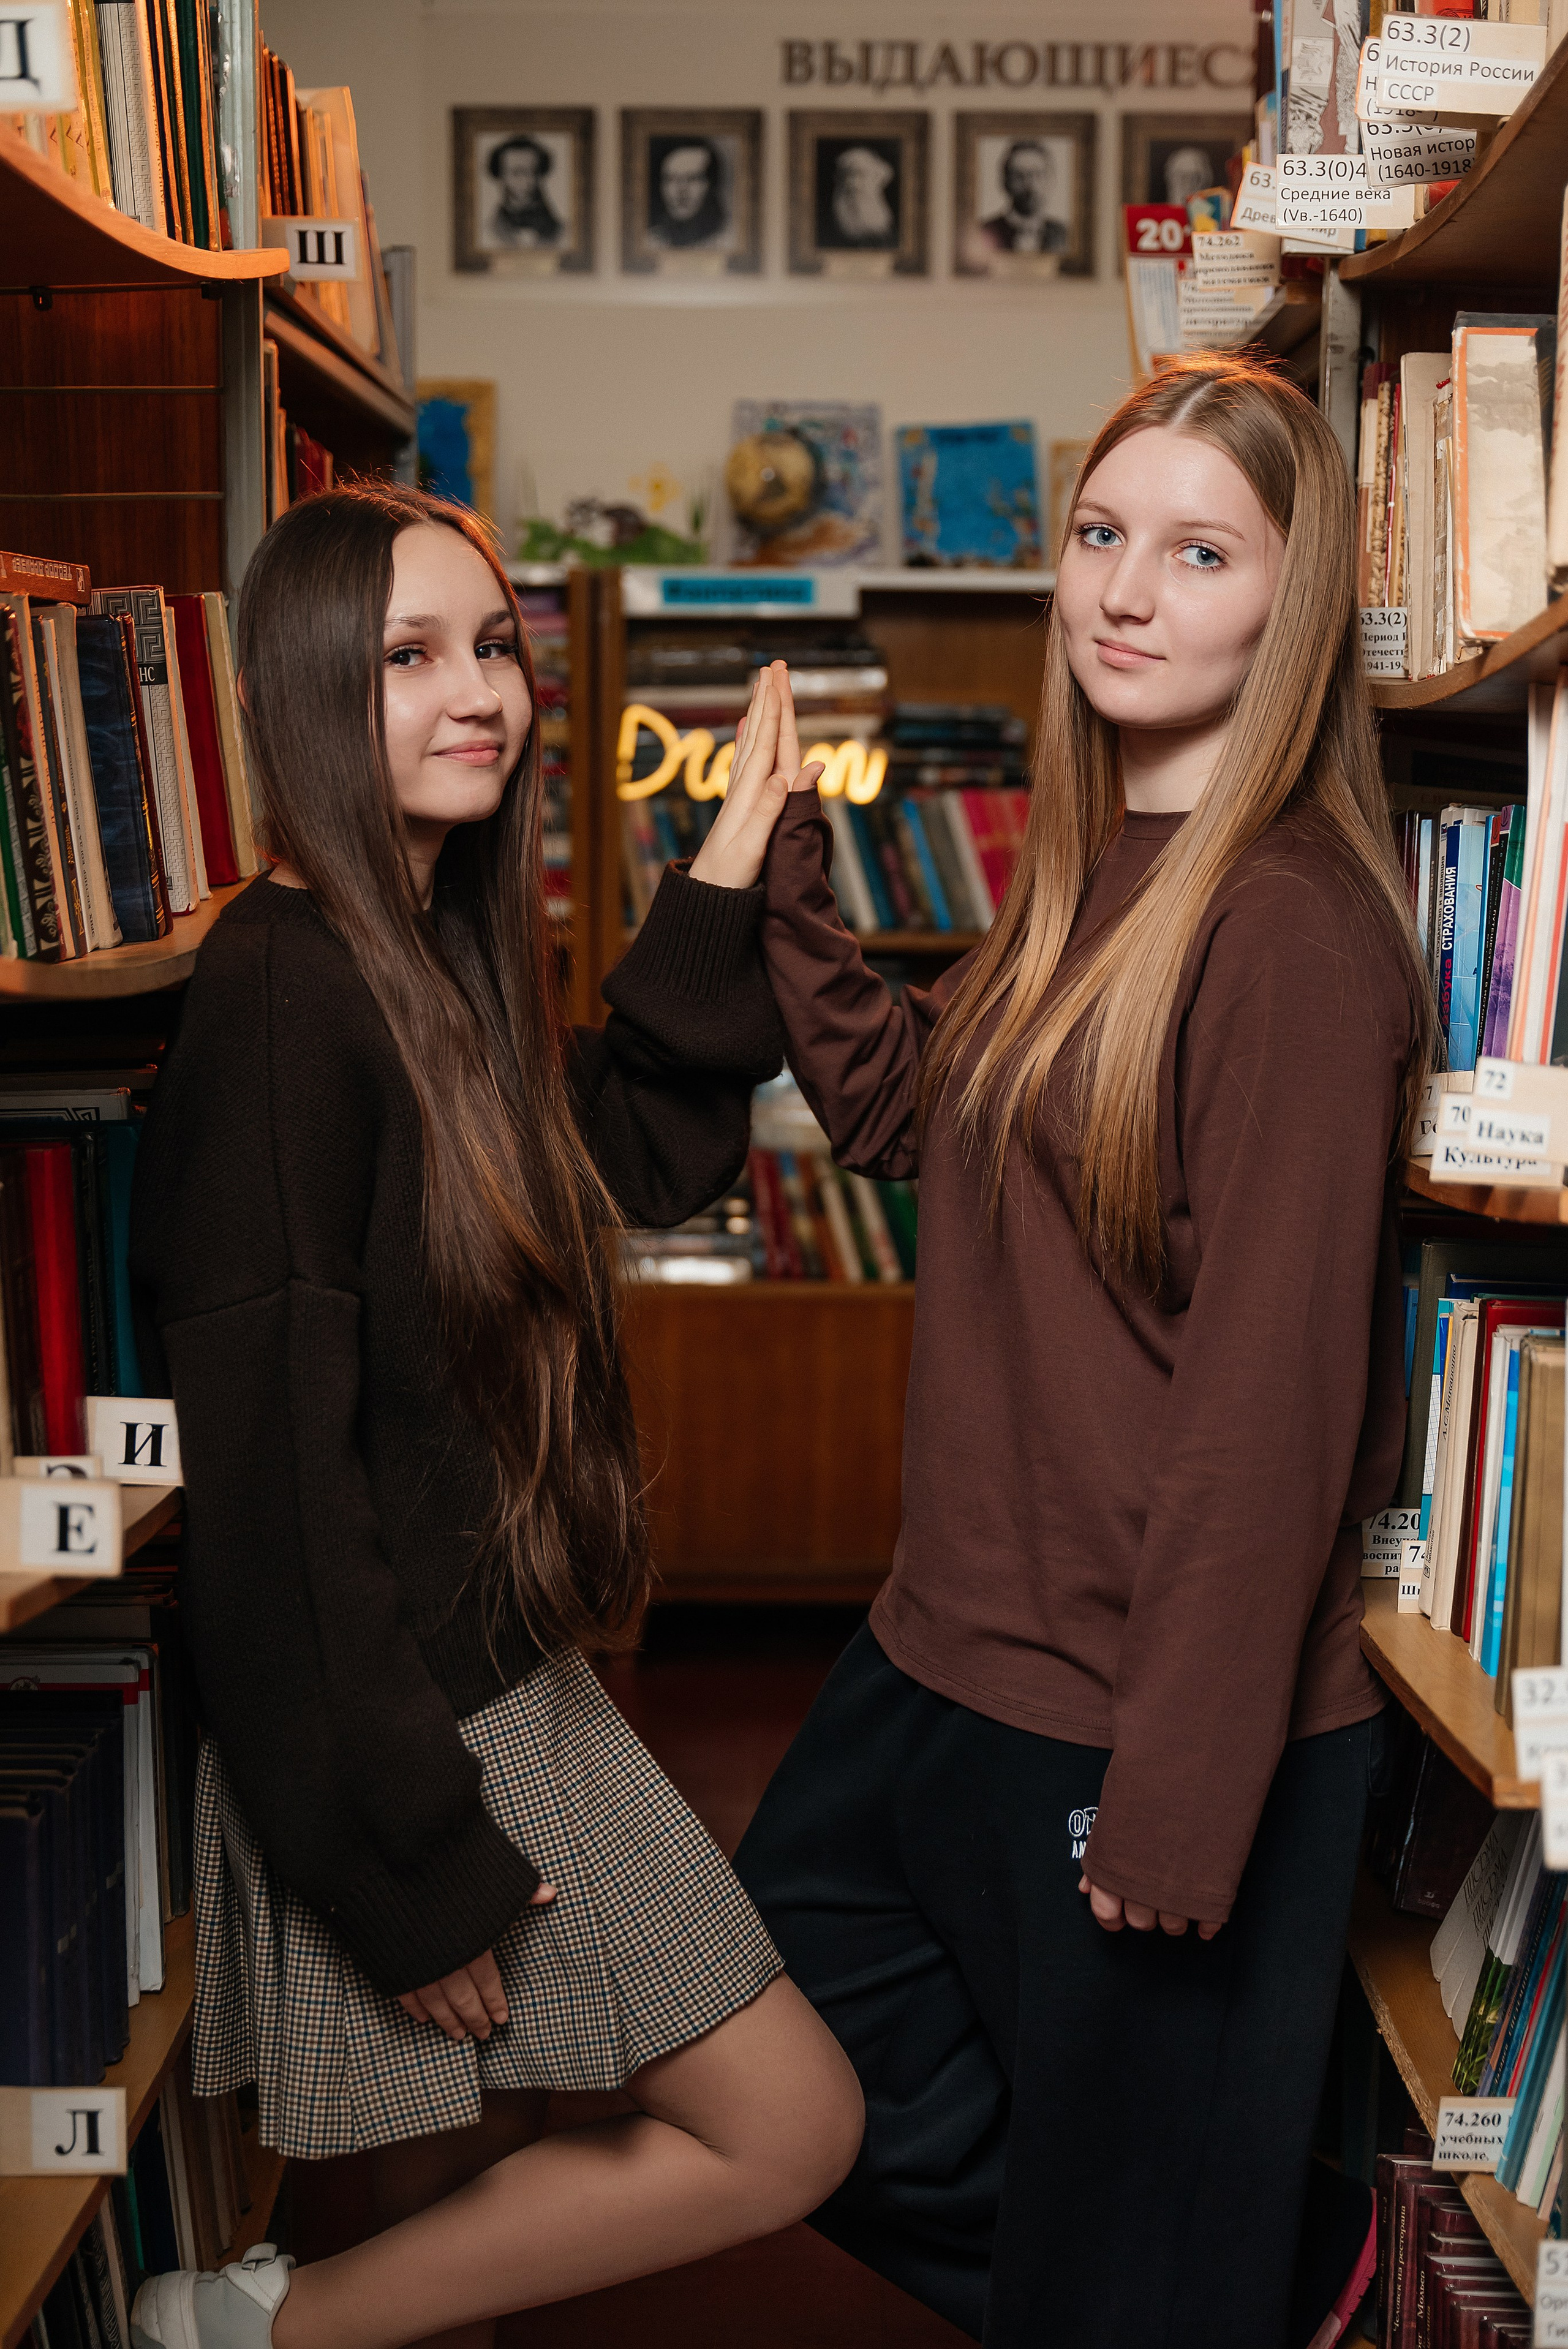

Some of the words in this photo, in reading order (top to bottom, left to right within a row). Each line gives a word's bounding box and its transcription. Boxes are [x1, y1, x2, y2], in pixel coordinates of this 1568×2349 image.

[1387, 20, 1471, 52] 63.3(2)
[782, 39, 1257, 94] ВЫДАЮЩИЕС
[1386, 55, 1463, 77] История
[1469, 62, 1534, 81] России
[1388, 83, 1434, 101] СССР
[1370, 145, 1421, 160] Новая
[1427, 138, 1475, 154] истор
[1283, 160, 1366, 181] 63.3(0)4
[1378, 157, 1475, 182] (1640-1918
[1281, 187, 1350, 203] Средние
[1355, 189, 1391, 200] века
[298, 230, 345, 265] Ш
[1136, 218, 1191, 252] 20
[616, 704, 888, 805] Drm
[1441, 866, 1457, 951] СТРАХОВАНИЯ
[1485, 910, 1497, 980] ПУТЕШЕСТВИЕ
[1479, 989, 1487, 1037] ИСТОРИЮ
[1485, 1070, 1507, 1090] 72
[1477, 1120, 1544, 1145] Наука
[118, 1421, 170, 1467] И
[54, 1503, 96, 1554] Е
[55, 2109, 105, 2157] Л
[1445, 2111, 1502, 2127] 74.260
[1439, 2133, 1504, 2146] учебных
[1392, 2284, 1402, 2332] Человек
[1398, 2205, 1406, 2264] ресторана
